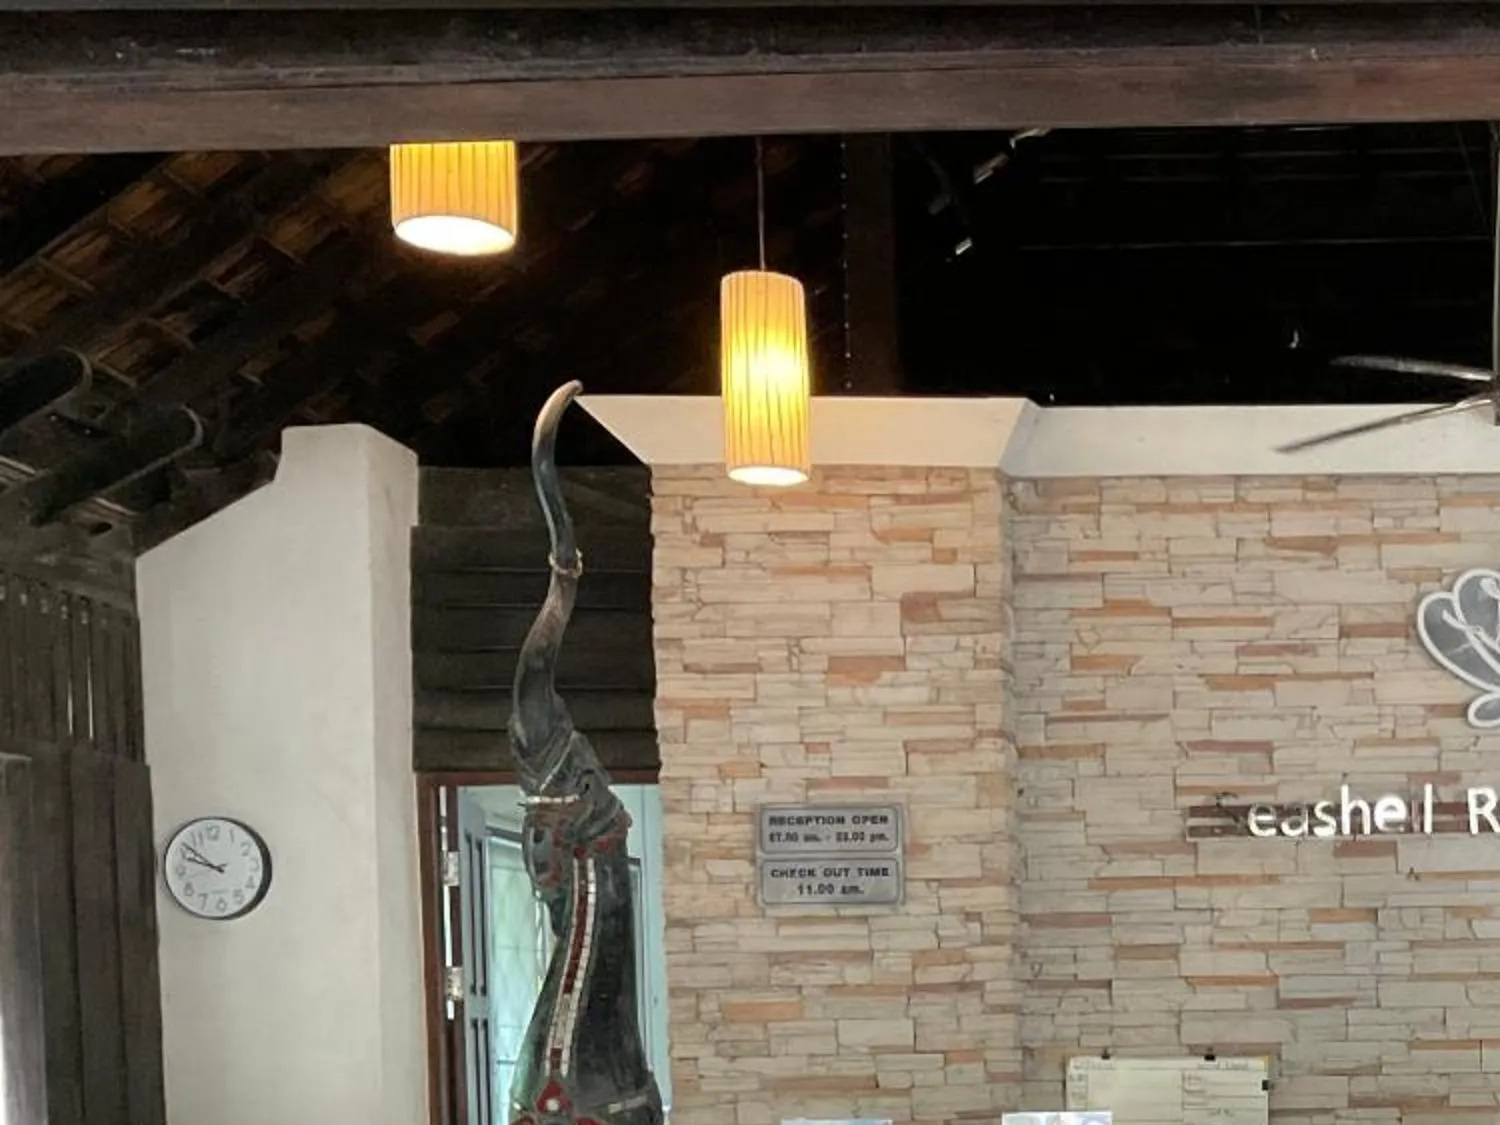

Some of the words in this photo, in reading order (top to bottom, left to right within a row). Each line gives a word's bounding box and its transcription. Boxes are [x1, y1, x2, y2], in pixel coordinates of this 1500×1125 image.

[768, 815, 846, 826] RECEPTION
[851, 815, 889, 825] OPEN
[770, 867, 817, 879] CHECK
[823, 867, 851, 878] OUT
[857, 867, 890, 878] TIME
[798, 883, 835, 896] 11.00
